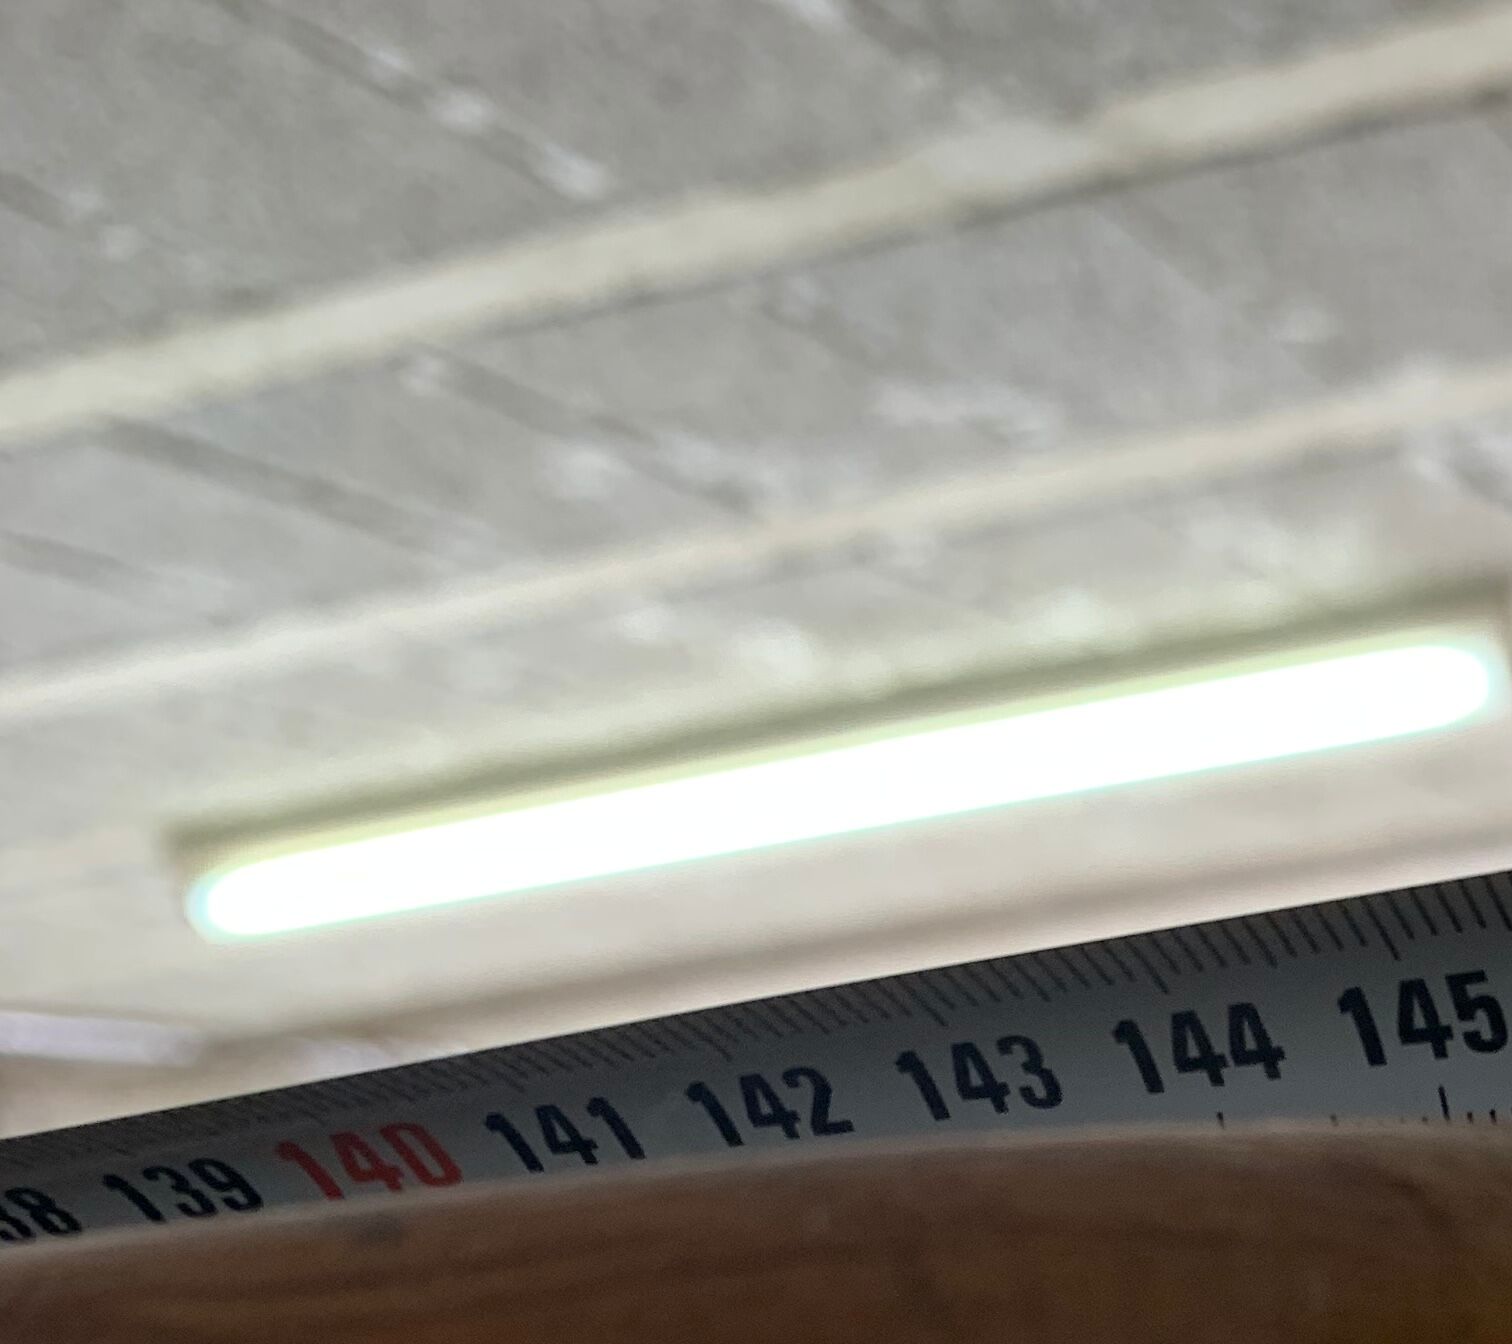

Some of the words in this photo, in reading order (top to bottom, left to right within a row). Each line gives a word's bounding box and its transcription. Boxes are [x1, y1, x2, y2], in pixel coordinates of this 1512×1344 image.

[0, 1187, 82, 1241] 38
[103, 1158, 264, 1223] 139
[274, 1122, 463, 1200] 140
[486, 1097, 645, 1173] 141
[685, 1066, 854, 1148] 142
[894, 1035, 1062, 1121] 143
[1111, 1002, 1285, 1094] 144
[1337, 969, 1508, 1067] 145
